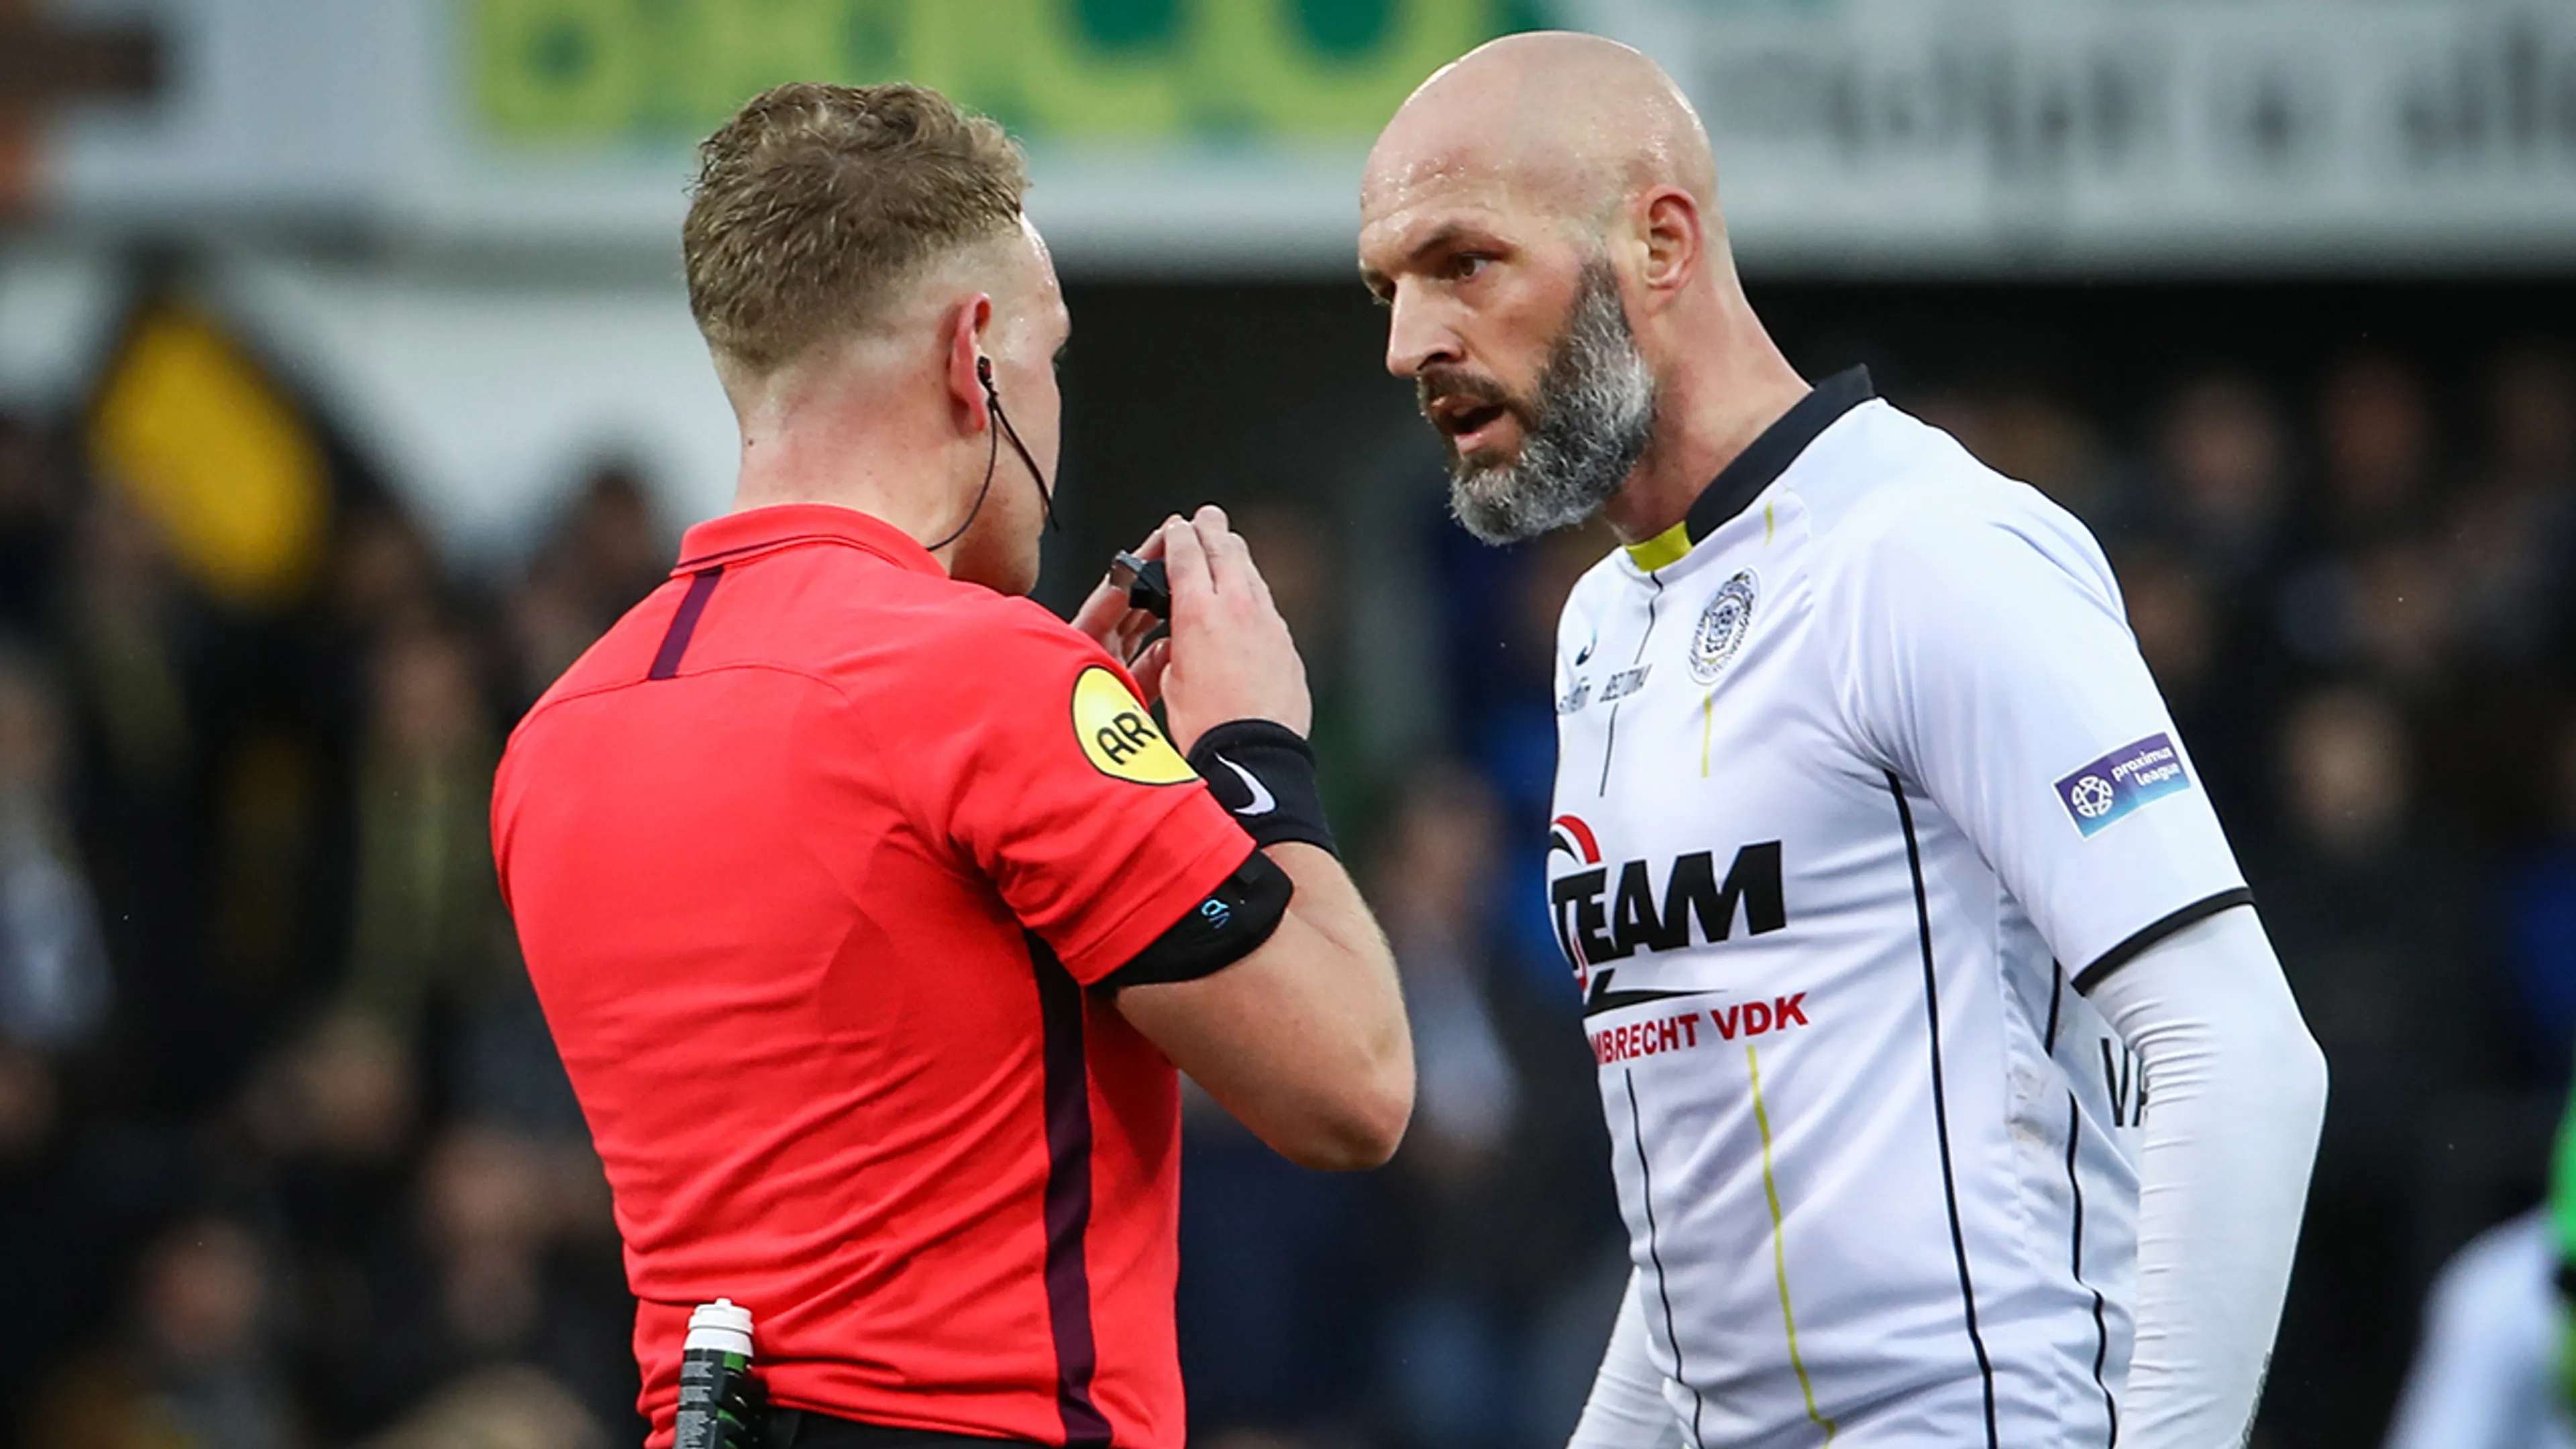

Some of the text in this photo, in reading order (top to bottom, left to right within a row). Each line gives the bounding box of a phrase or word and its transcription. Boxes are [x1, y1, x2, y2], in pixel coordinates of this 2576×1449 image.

[1096, 704, 1158, 765] AR
[1552, 839, 1786, 970] TEAM
[1711, 991, 1809, 1041] VDK
